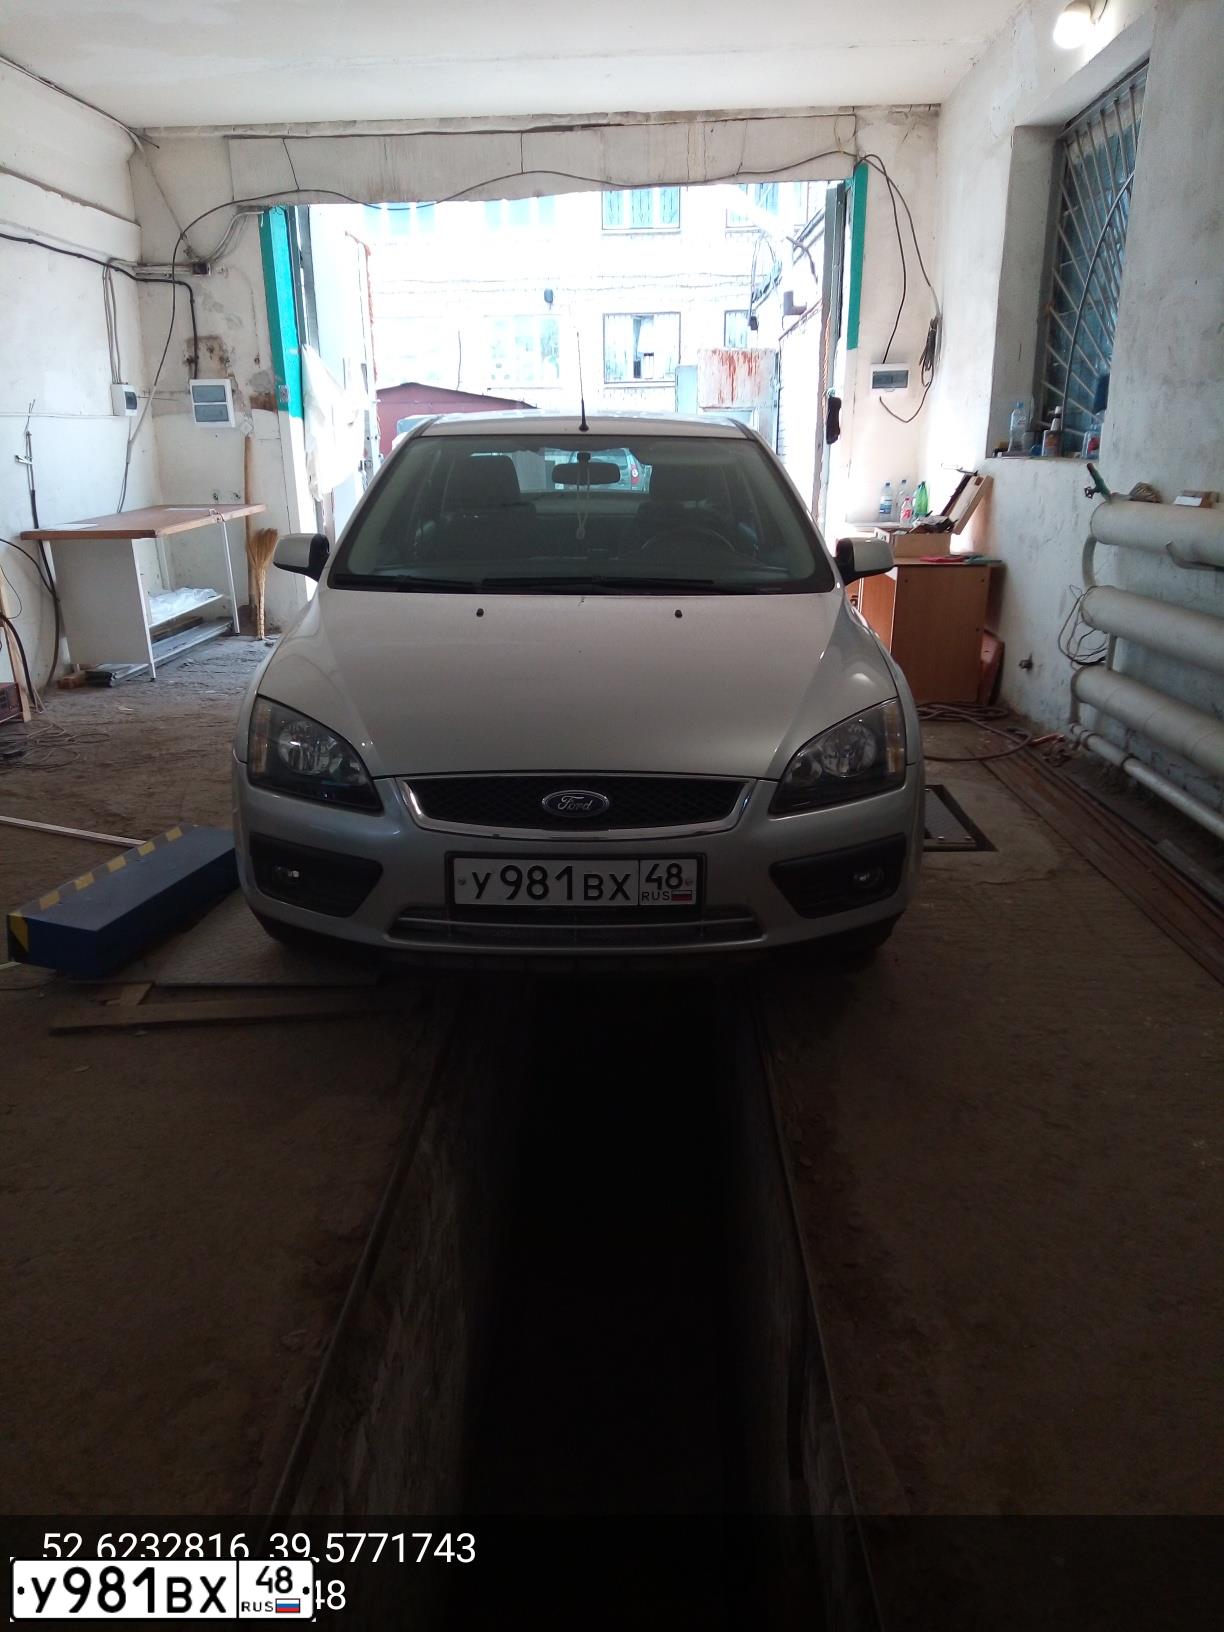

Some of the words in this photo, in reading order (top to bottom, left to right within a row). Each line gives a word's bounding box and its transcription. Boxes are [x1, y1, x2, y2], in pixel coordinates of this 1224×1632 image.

[557, 795, 593, 811] Ford
[645, 862, 684, 891] 48
[641, 891, 671, 902] RUS
